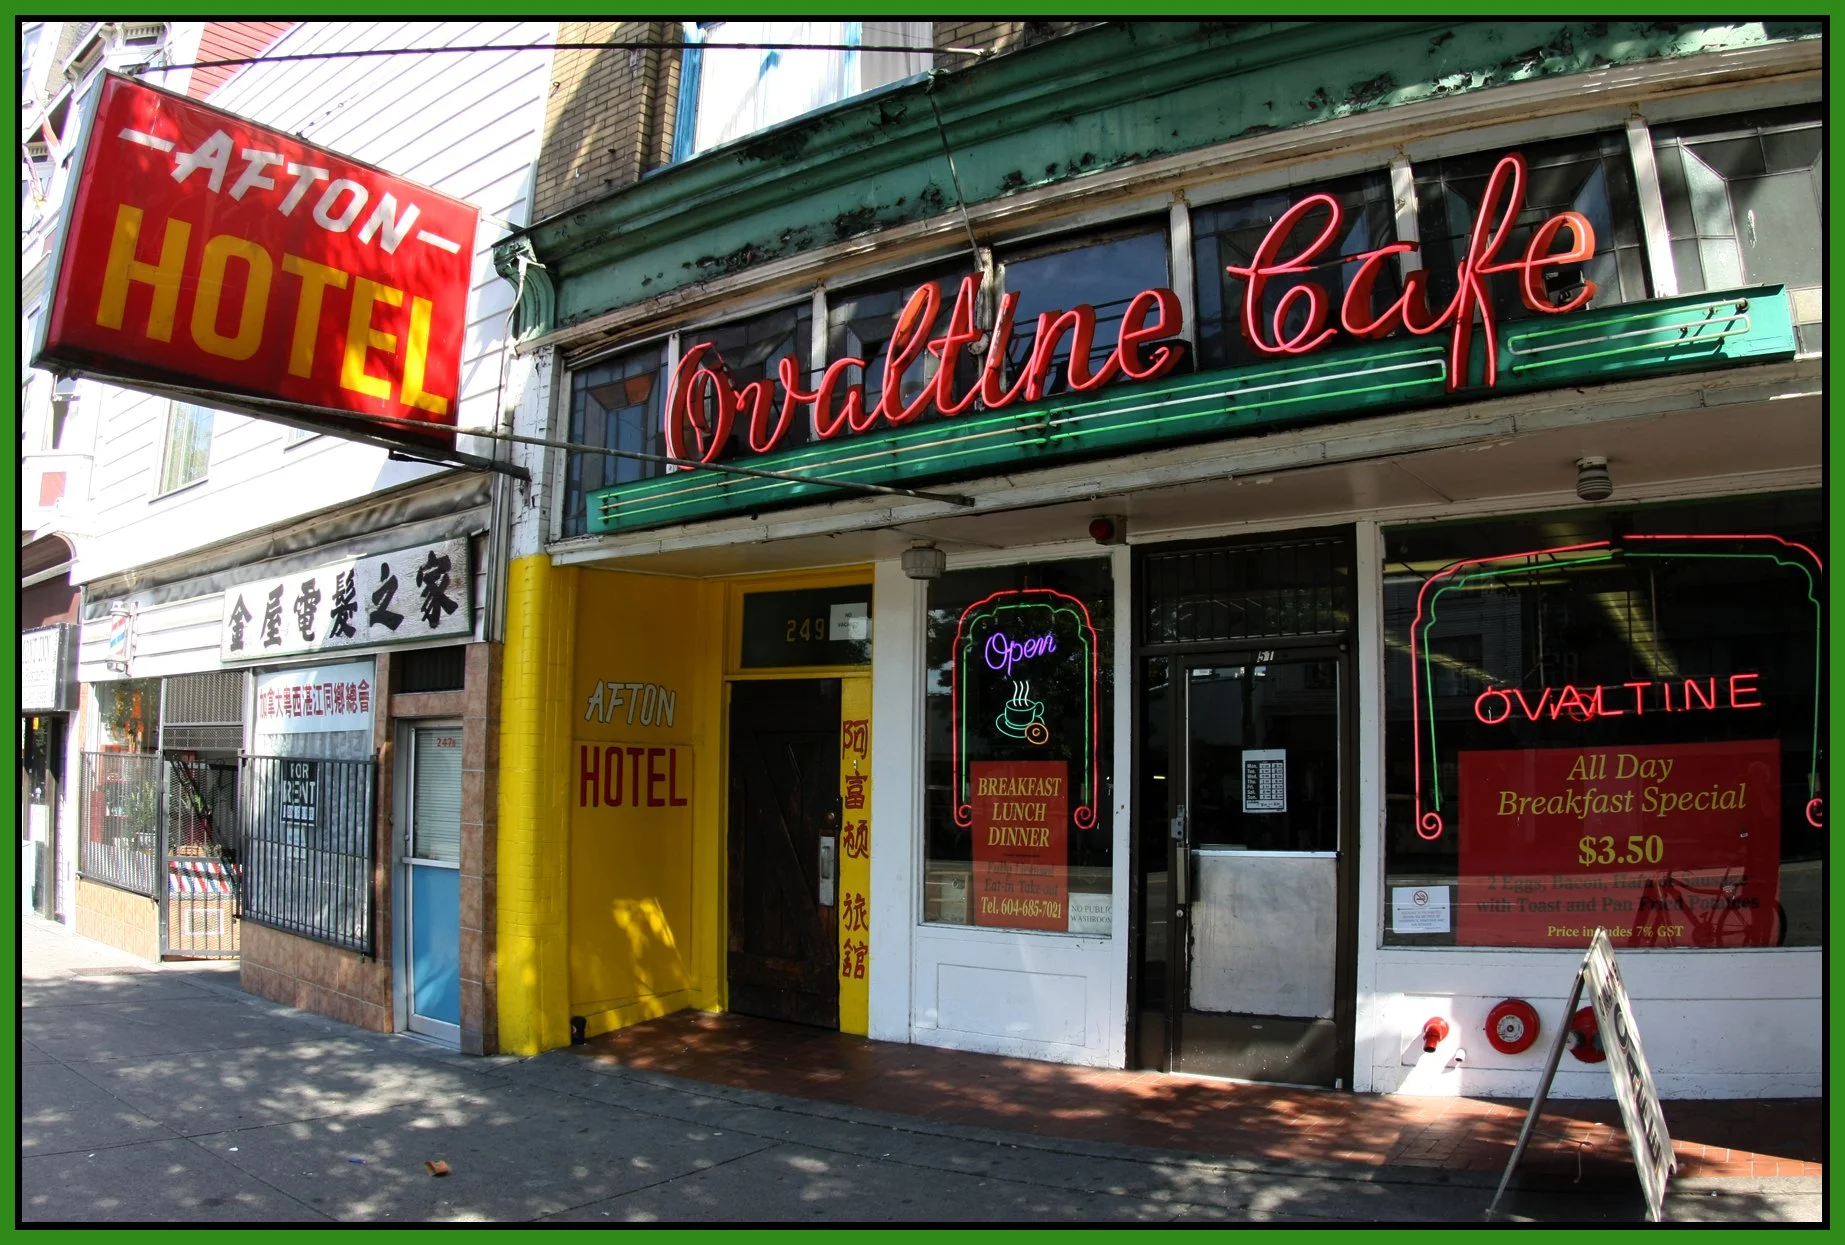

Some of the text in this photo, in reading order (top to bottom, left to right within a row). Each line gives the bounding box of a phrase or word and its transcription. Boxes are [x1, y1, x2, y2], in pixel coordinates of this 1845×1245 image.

[172, 129, 421, 255] AFTON
[95, 203, 449, 416] HOTEL
[664, 152, 1597, 470] Ovaltine Cafe
[228, 550, 459, 652] 金屋電髮之家
[786, 617, 825, 643] 249
[984, 632, 1057, 675] Open
[584, 679, 678, 728] AFTON
[1474, 673, 1763, 725] OVALTINE
[290, 763, 309, 779] FOR
[580, 745, 688, 808] HOTEL
[1567, 755, 1673, 782] All Day
[977, 777, 1062, 797] BREAKFAST
[1498, 783, 1746, 819] Breakfast Special
[992, 802, 1047, 822] LUNCH
[988, 827, 1050, 848] DINNER
[1578, 834, 1664, 866] $3.50
[981, 897, 1062, 919] Tel. 604-685-7021
[1517, 898, 1562, 912] Toast
[1566, 898, 1598, 912] and
[1602, 897, 1633, 912] Pan
[1547, 926, 1684, 937] Price inudes 7% GST
